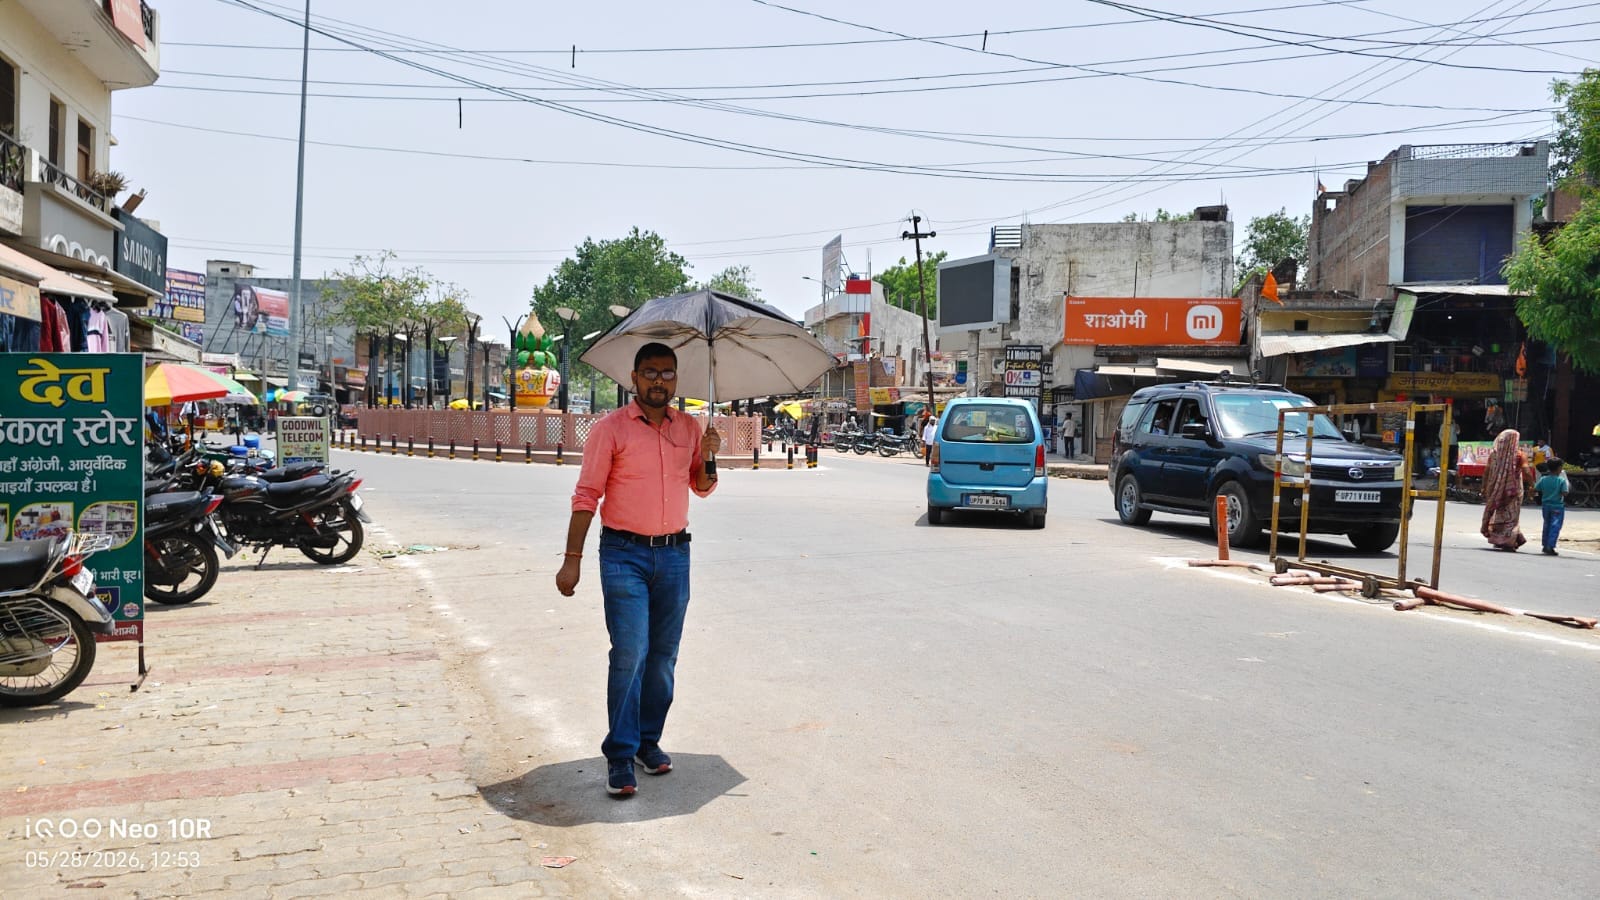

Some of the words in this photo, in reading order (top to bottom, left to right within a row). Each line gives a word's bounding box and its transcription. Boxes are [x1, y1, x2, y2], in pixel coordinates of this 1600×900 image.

[123, 236, 162, 277] SAMSUG
[1083, 309, 1148, 329] शाओमी
[17, 358, 111, 408] देव
[1006, 370, 1023, 385] 0%
[1005, 387, 1040, 396] FINANCE
[72, 409, 138, 446] स्टोर
[282, 420, 323, 430] GOODWIL
[281, 432, 323, 443] TELECOM
[100, 567, 120, 581] भारी
